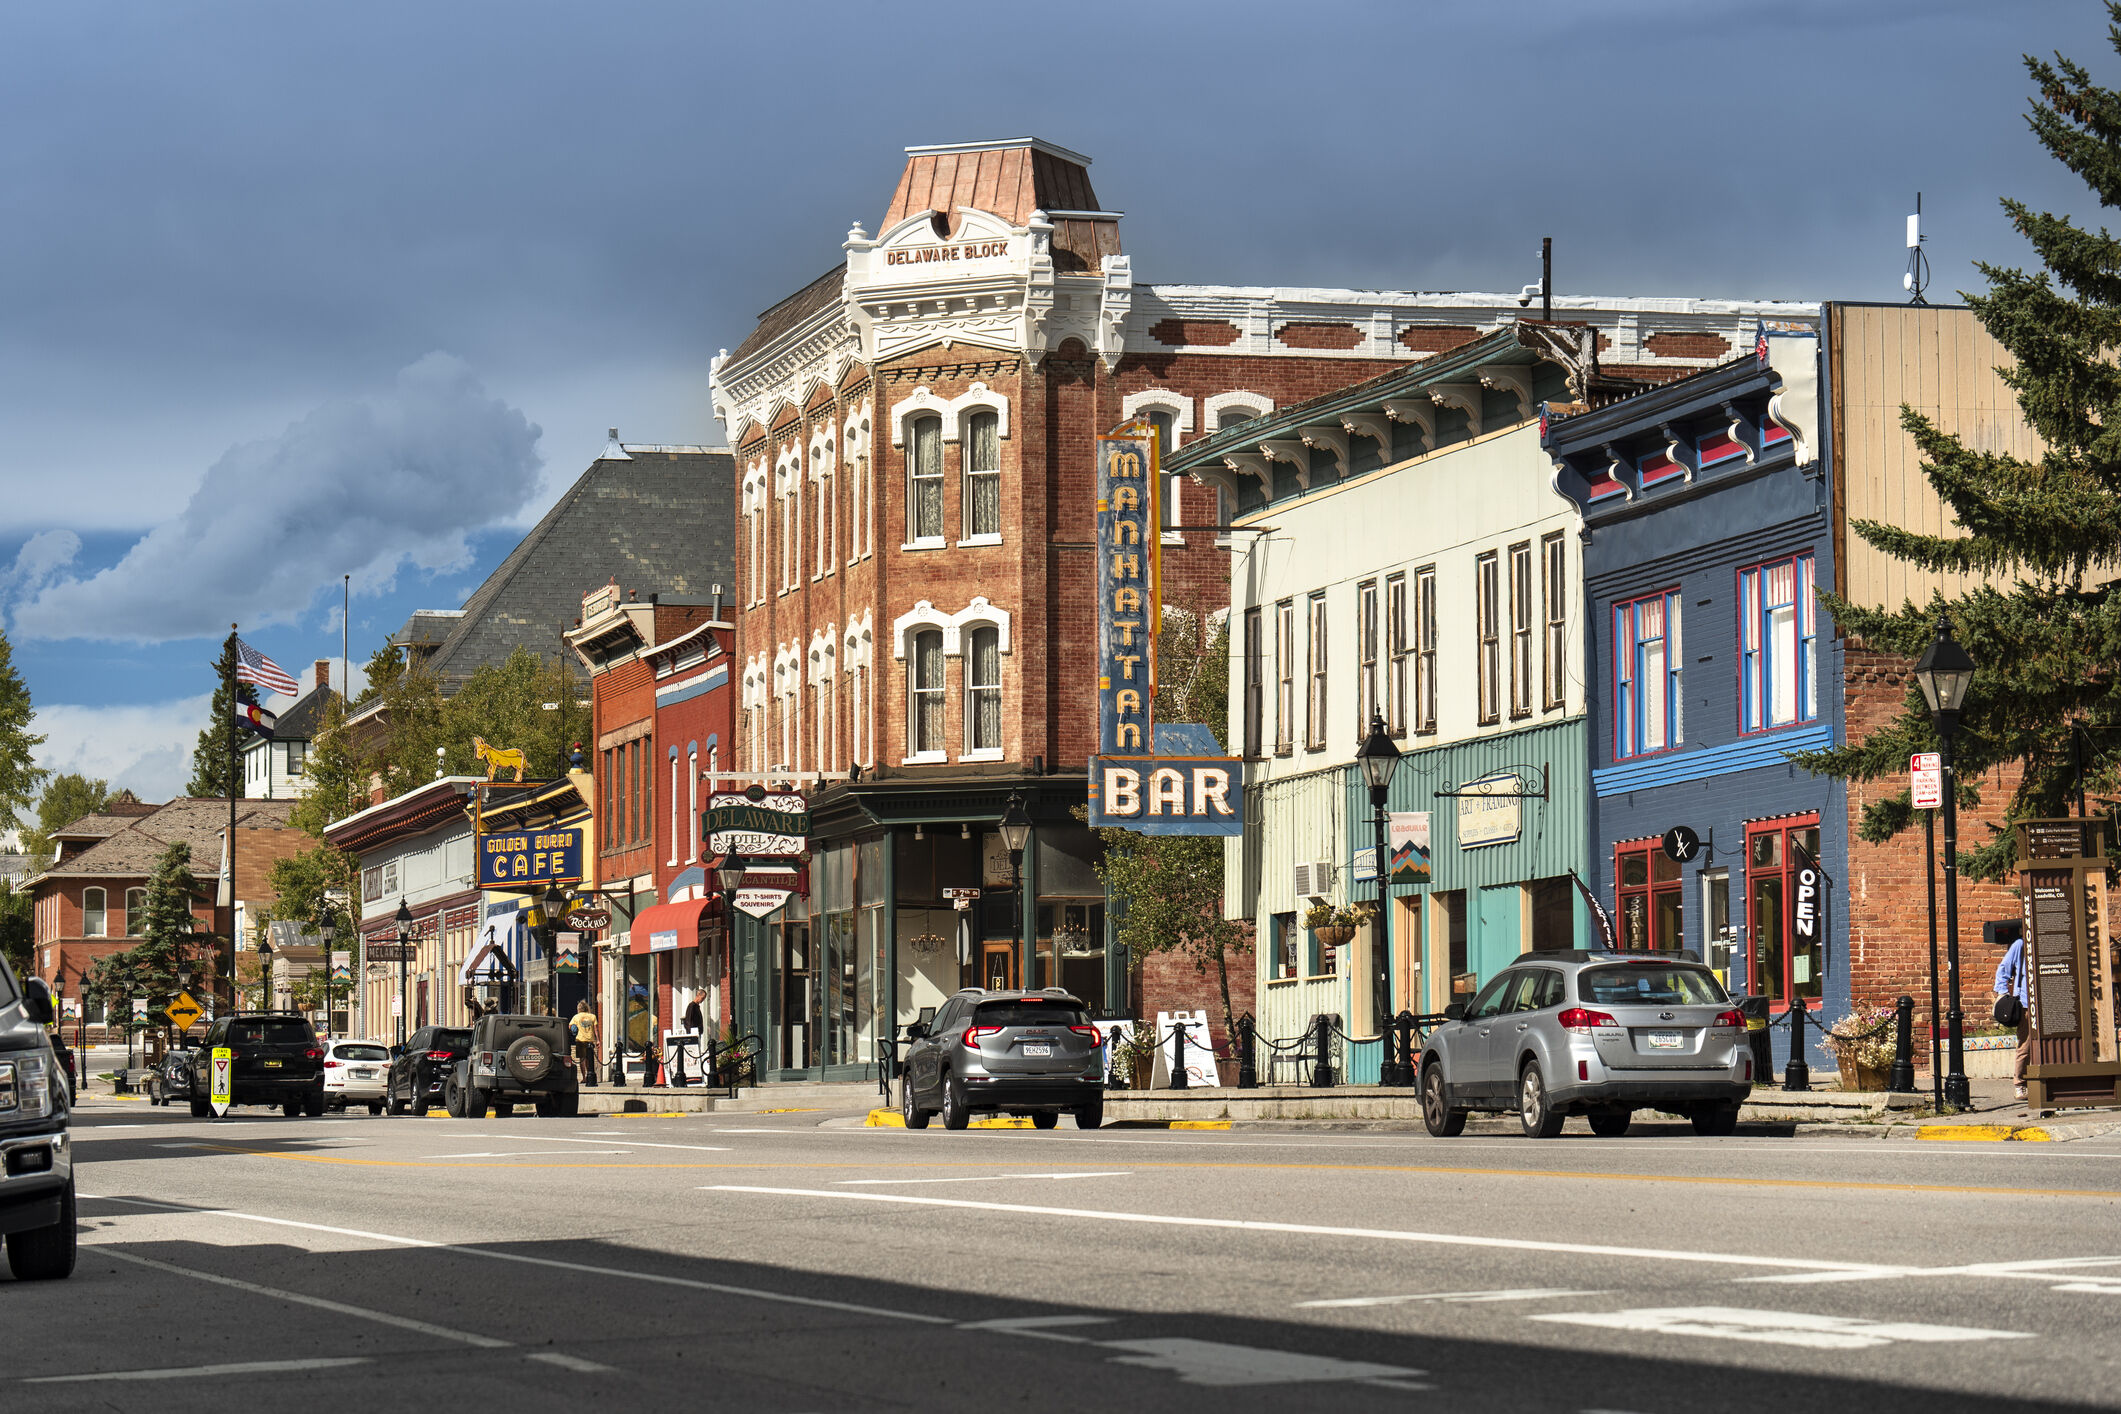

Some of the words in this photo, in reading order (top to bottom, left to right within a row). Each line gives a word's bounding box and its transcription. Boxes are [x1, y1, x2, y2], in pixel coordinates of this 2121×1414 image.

[887, 246, 960, 265] DELAWARE
[964, 242, 1008, 259] BLOCK
[1109, 450, 1143, 749] MANHATTAN
[1913, 757, 1919, 769] 4
[1103, 767, 1235, 817] BAR
[1460, 798, 1473, 816] ART
[1482, 791, 1518, 812] FRAMING
[705, 808, 809, 833] DELAWARE
[487, 836, 528, 853] GOLDEN
[534, 833, 573, 850] BURRO
[725, 834, 766, 844] HOTEL
[493, 851, 565, 878] CAFE
[959, 889, 971, 897] 7th
[1796, 869, 1816, 937] OPEN
[571, 917, 593, 928] ROCK
[593, 915, 608, 928] HUT
[2083, 884, 2104, 1001] LEADVILLE
[2023, 895, 2037, 1030] INFORMATION
